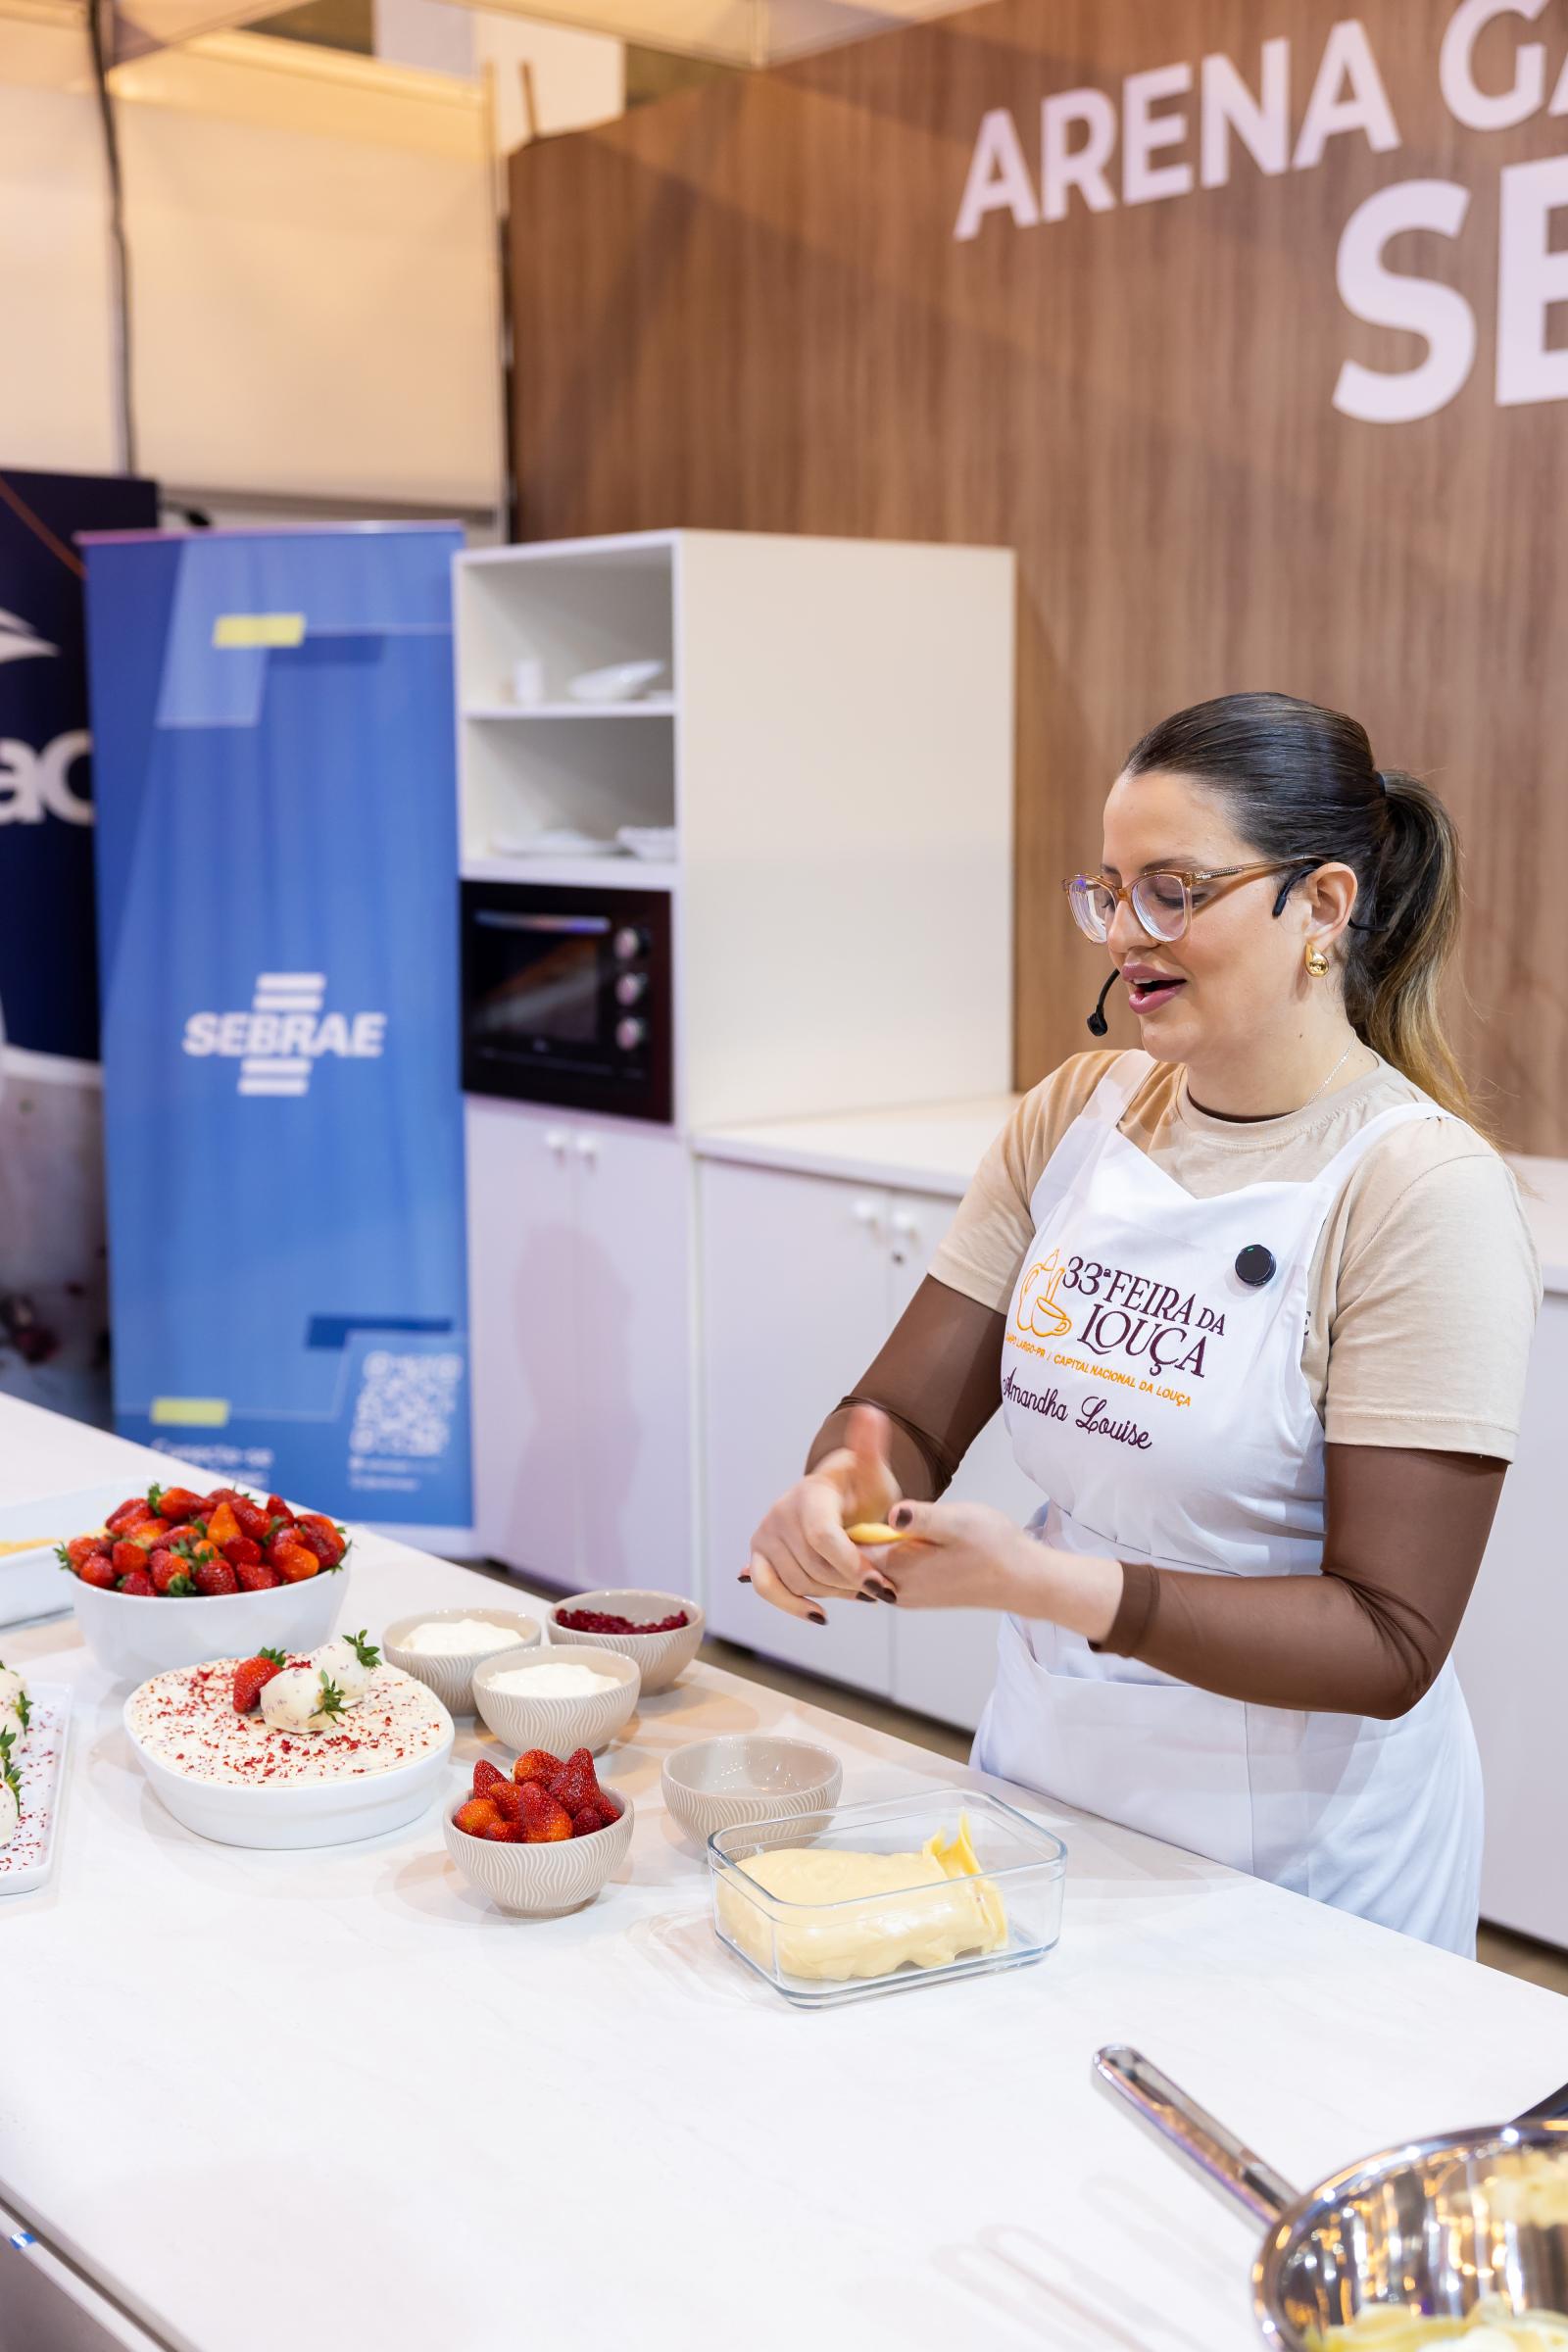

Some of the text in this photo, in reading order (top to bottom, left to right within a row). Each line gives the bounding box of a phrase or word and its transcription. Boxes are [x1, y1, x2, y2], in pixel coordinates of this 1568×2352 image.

[954, 0, 1568, 242] ARENA G
[1331, 155, 1568, 423] SE
[182, 1011, 388, 1056] SEBRAE
[1077, 1303, 1206, 1379] LOUÇA
[1102, 1270, 1197, 1326] FEIRA
[1195, 1307, 1226, 1337] DA
[1003, 1366, 1153, 1449] Amandha Louise
[1054, 1354, 1089, 1373] CAPITAL
[1089, 1365, 1136, 1388] NACIONAL
[1139, 1380, 1153, 1394] DA
[1155, 1386, 1192, 1407] LOUÇA
